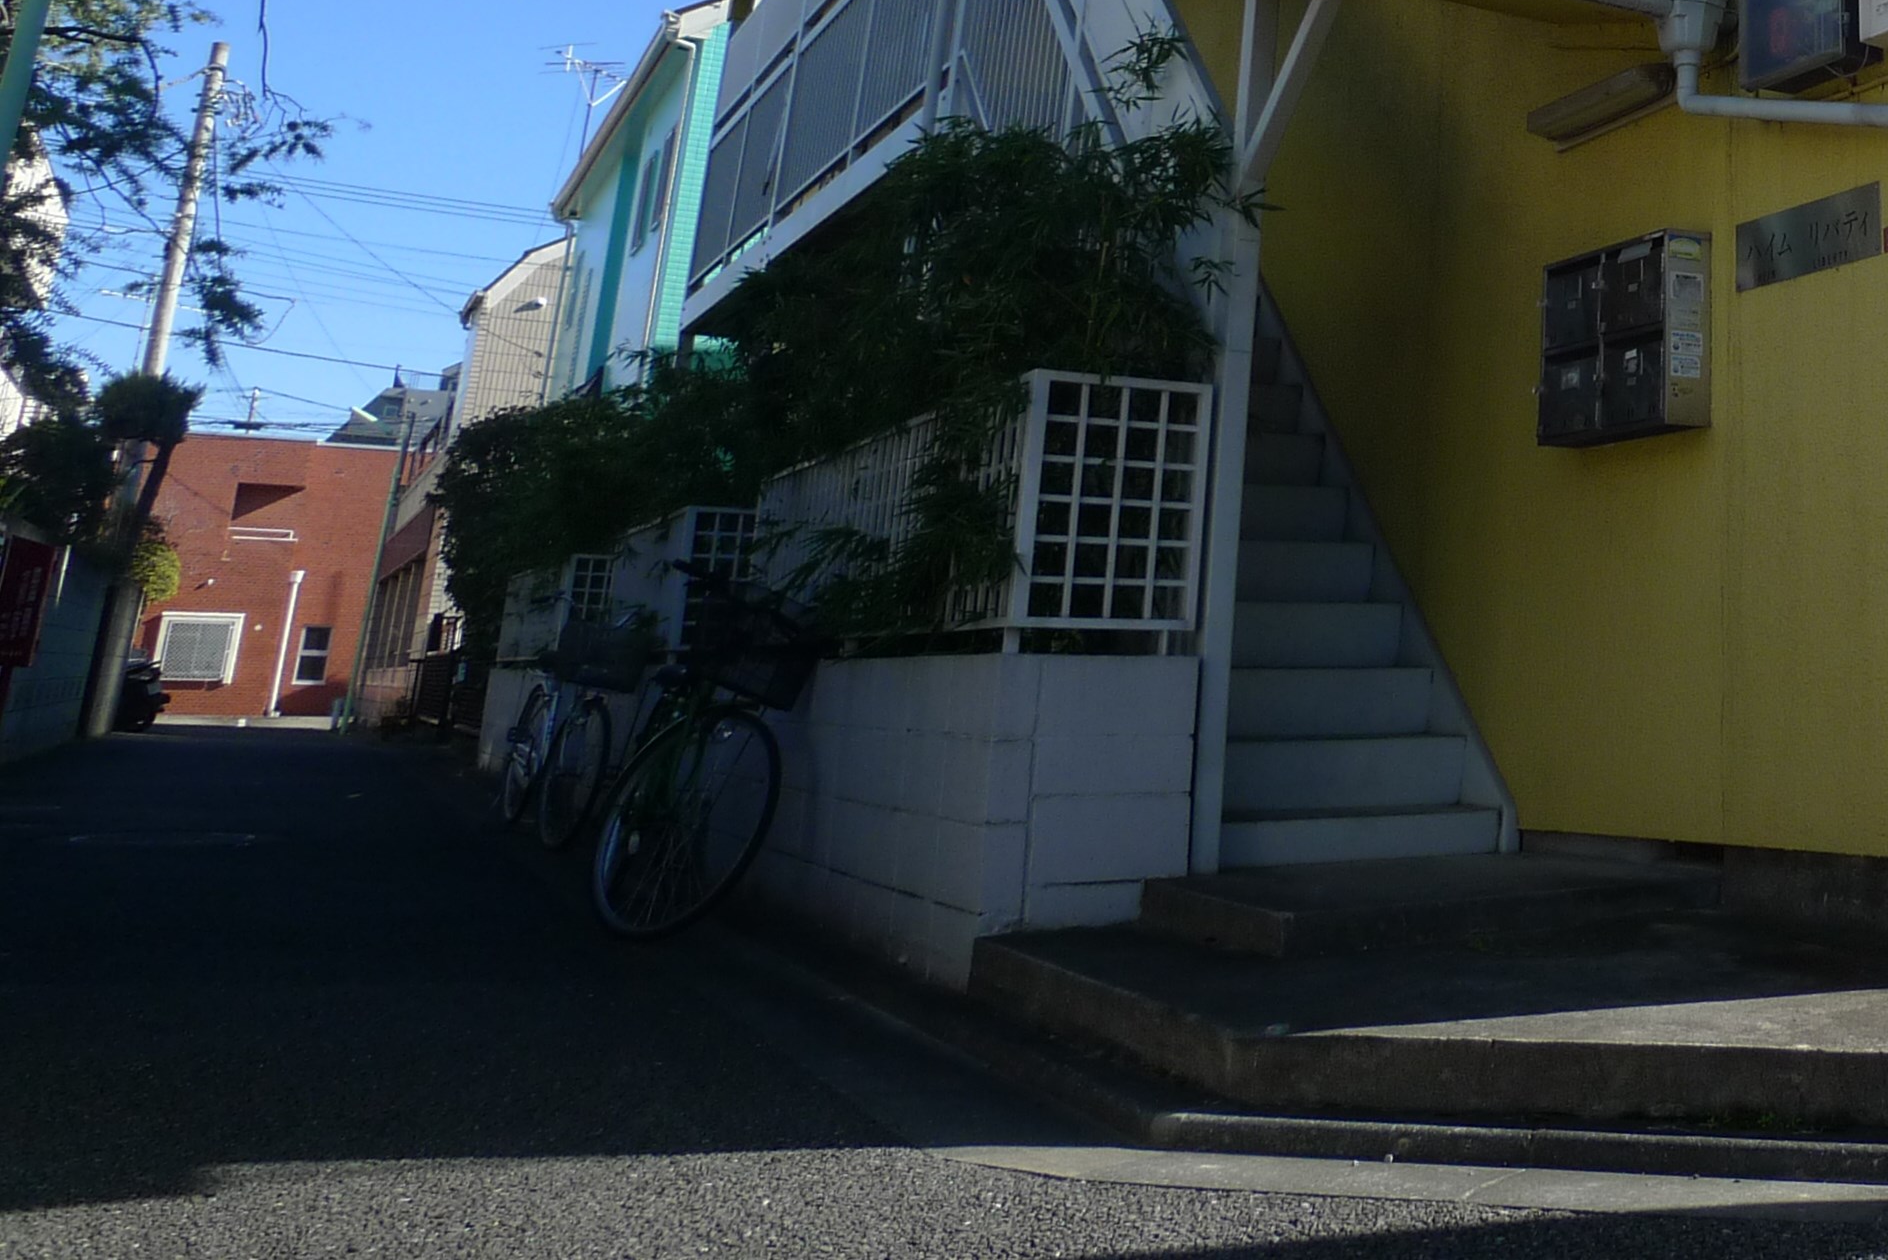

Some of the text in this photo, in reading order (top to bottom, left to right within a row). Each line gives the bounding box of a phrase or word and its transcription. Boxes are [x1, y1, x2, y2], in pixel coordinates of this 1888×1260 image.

[1747, 210, 1868, 261] ハイム リバティ
